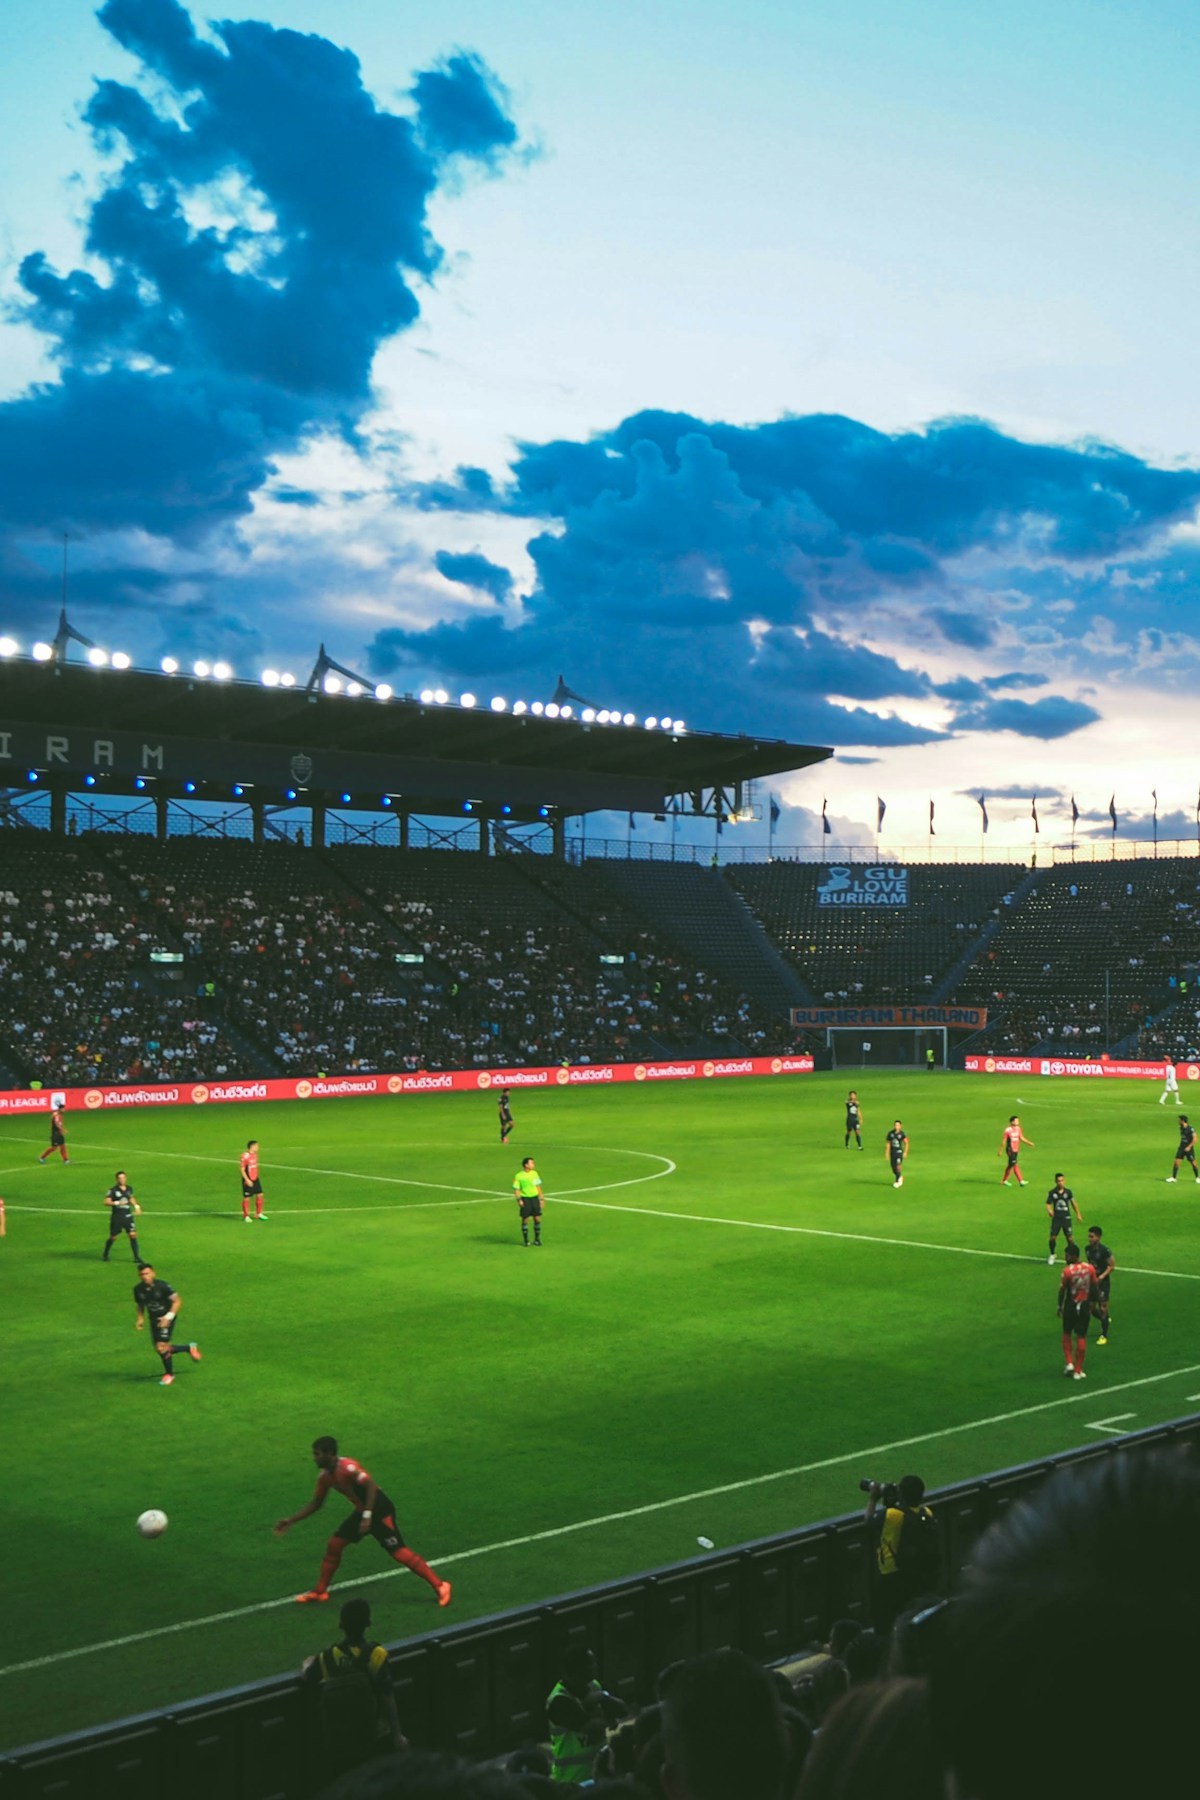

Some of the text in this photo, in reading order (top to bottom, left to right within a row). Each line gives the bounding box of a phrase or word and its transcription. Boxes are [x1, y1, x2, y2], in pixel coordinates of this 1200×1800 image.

[864, 867, 908, 880] GU
[853, 881, 908, 893] LOVE
[820, 893, 907, 904] BURIRAM
[796, 1008, 980, 1025] BURIRAM THAILAND
[1064, 1063, 1104, 1075] TOYOTA
[1117, 1066, 1142, 1074] PREMIER
[1142, 1067, 1165, 1075] LEAGUE
[10, 1097, 48, 1108] LEAGUE
